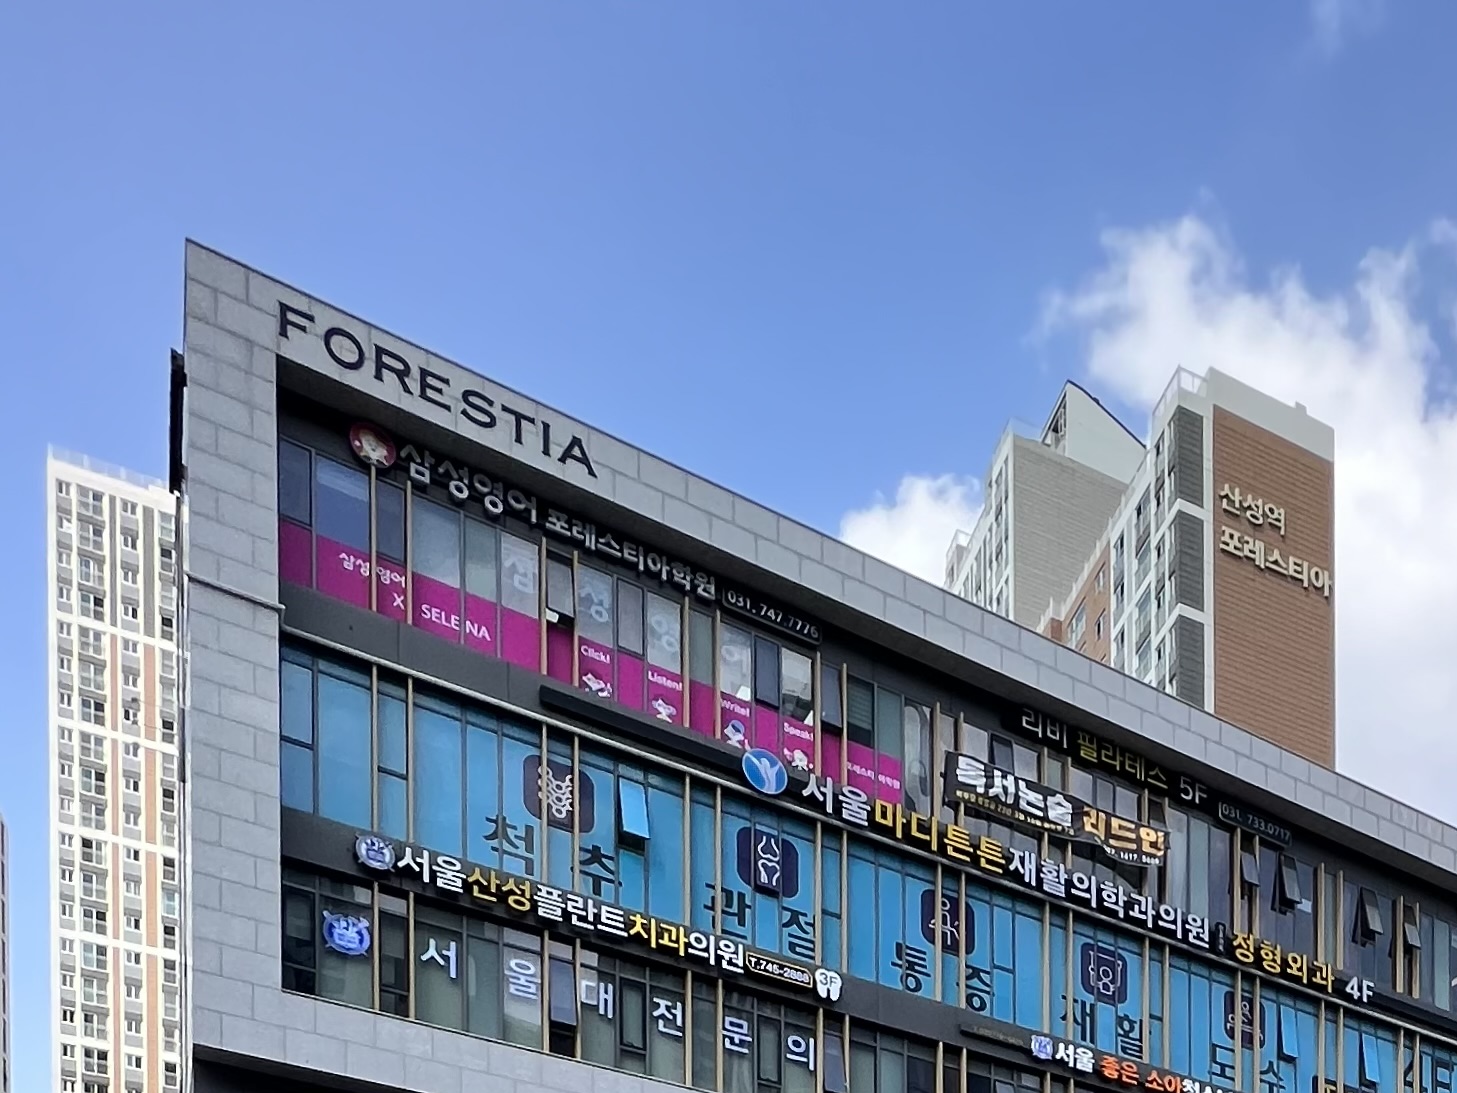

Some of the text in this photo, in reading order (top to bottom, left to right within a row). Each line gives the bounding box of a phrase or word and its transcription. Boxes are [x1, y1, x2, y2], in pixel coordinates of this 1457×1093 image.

[277, 300, 598, 479] FORESTIA
[400, 444, 538, 525] 삼성영어
[545, 507, 716, 600] 포레스티아학원
[1219, 483, 1286, 536] 산성역
[1219, 525, 1333, 598] 포레스티아
[421, 603, 492, 642] SELENA
[1021, 706, 1069, 750] 리비
[1077, 731, 1169, 790] 필라테스
[1179, 775, 1208, 806] 5F
[1233, 931, 1336, 994] 정형외과
[1344, 975, 1376, 1003] 4F
